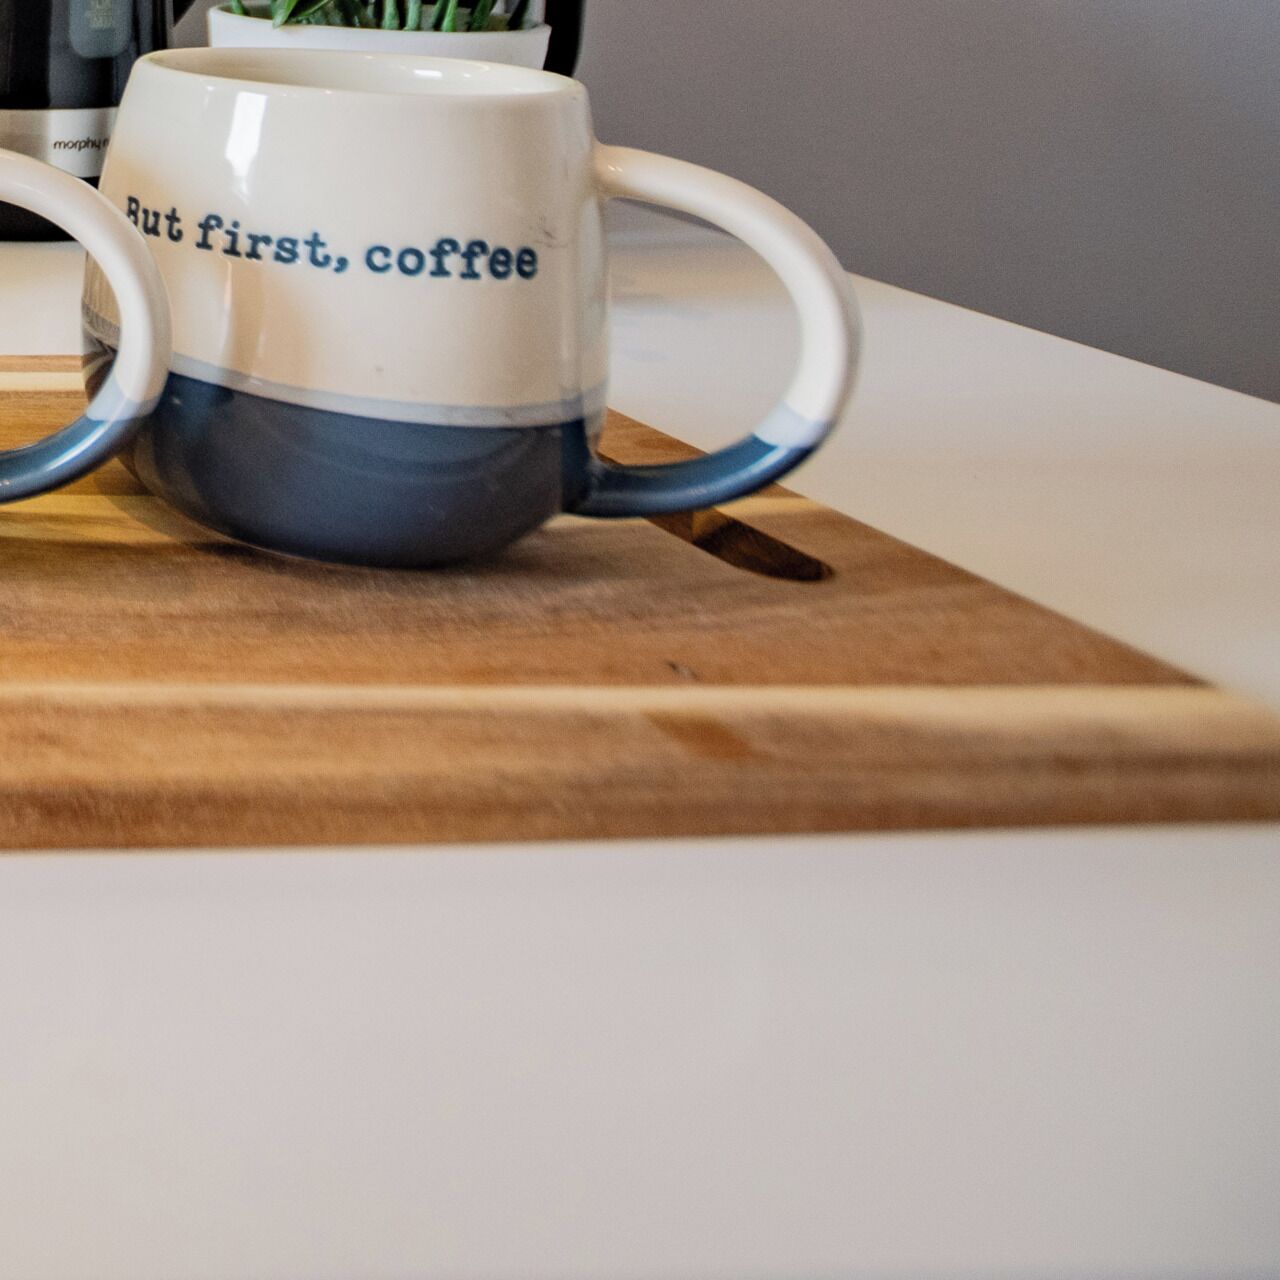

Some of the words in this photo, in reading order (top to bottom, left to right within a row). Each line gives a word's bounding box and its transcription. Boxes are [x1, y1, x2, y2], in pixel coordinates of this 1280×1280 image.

[53, 136, 101, 151] morphy
[127, 195, 184, 243] But
[195, 213, 350, 274] first,
[364, 237, 539, 281] coffee
